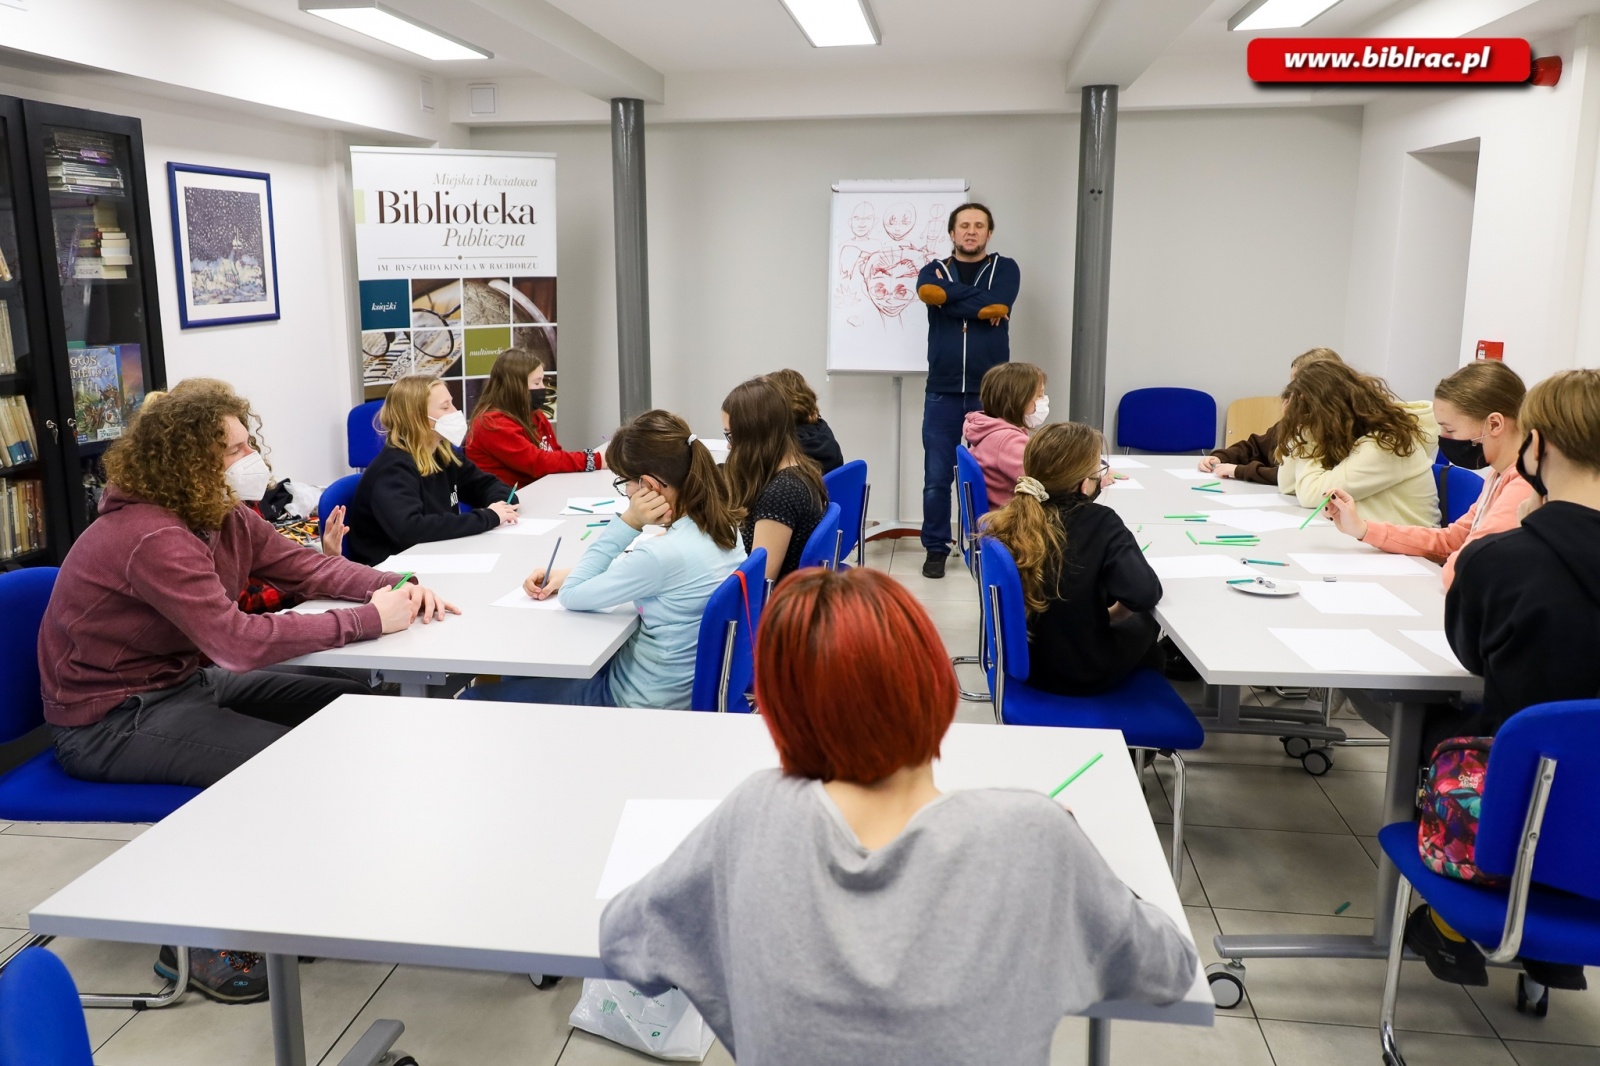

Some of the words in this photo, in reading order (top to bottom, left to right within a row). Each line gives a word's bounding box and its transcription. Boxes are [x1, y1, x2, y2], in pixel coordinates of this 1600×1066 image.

[433, 173, 474, 188] Miejska
[476, 175, 480, 185] i
[483, 174, 538, 187] Powiatowa
[376, 190, 537, 225] Biblioteka
[442, 228, 525, 248] Publiczna
[489, 262, 539, 270] RACIBORZU
[371, 301, 397, 312] książki
[469, 347, 504, 356] multimedi
[70, 354, 98, 368] OWS
